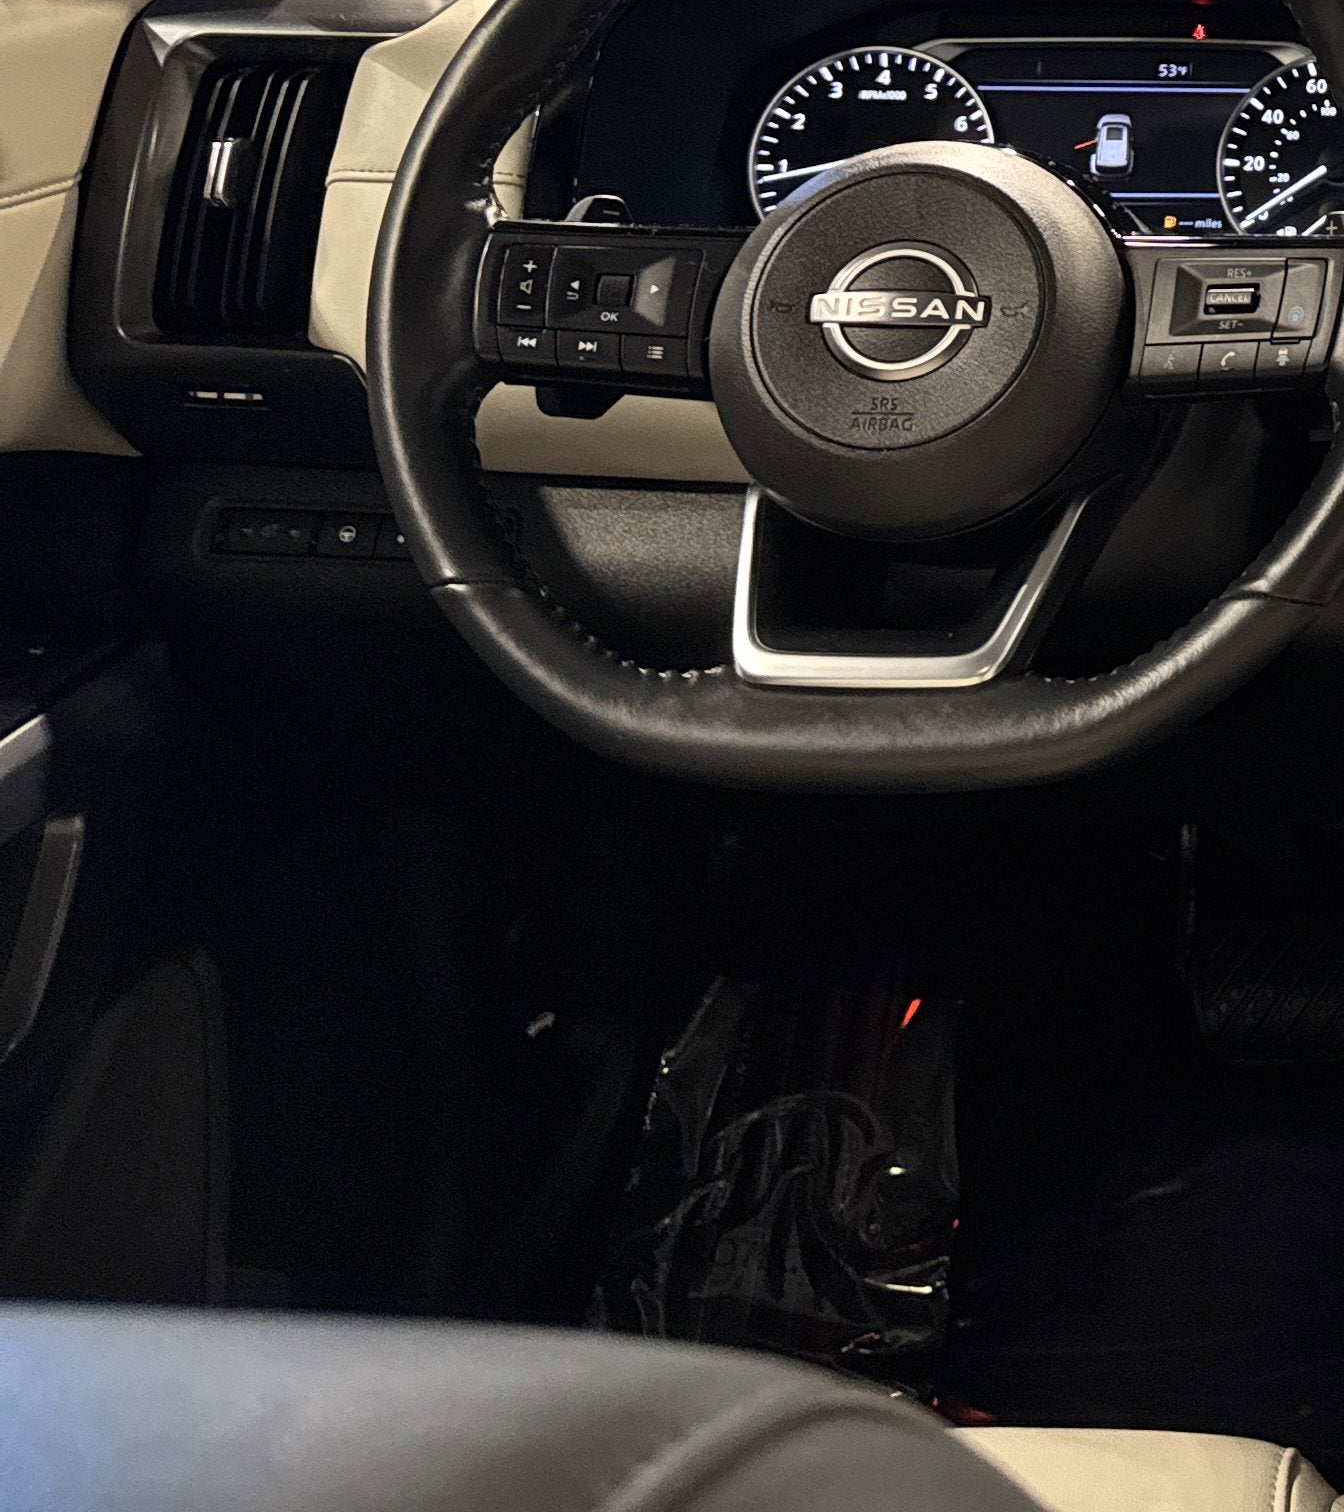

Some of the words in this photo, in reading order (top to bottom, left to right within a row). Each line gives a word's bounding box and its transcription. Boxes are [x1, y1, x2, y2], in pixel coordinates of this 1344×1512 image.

[875, 69, 891, 86] 4
[827, 81, 843, 99] 3
[924, 83, 938, 100] 5
[1305, 79, 1328, 94] 60
[790, 113, 806, 130] 2
[954, 115, 968, 132] 6
[1261, 109, 1284, 124] 40
[778, 159, 788, 173] 1
[1243, 156, 1265, 171] 20
[1194, 218, 1222, 229] miles
[1209, 292, 1249, 303] CANCEL
[816, 296, 985, 321] NISSAN
[600, 311, 619, 322] OK
[870, 397, 899, 411] SRS
[851, 417, 914, 432] AIRBAG
